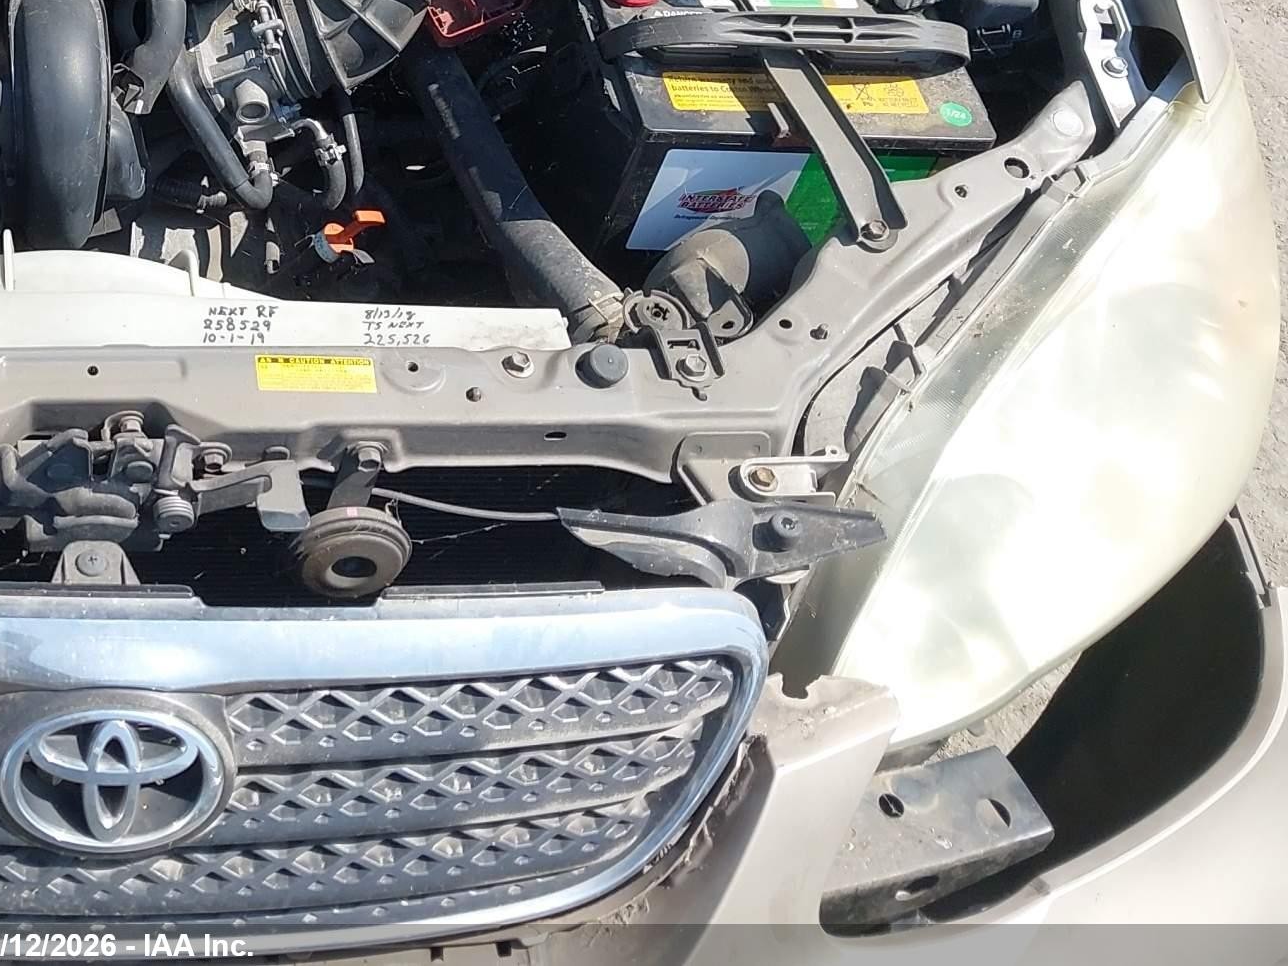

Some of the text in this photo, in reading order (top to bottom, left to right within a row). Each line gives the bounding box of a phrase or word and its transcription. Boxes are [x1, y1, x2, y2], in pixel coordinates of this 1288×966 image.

[671, 84, 709, 92] batteries
[679, 192, 754, 203] INTERSTATE
[677, 201, 745, 210] BATTERIES
[208, 306, 248, 316] NEXT
[388, 321, 424, 329] NEXT
[363, 333, 431, 346] 225,526
[289, 357, 325, 365] CAUTION
